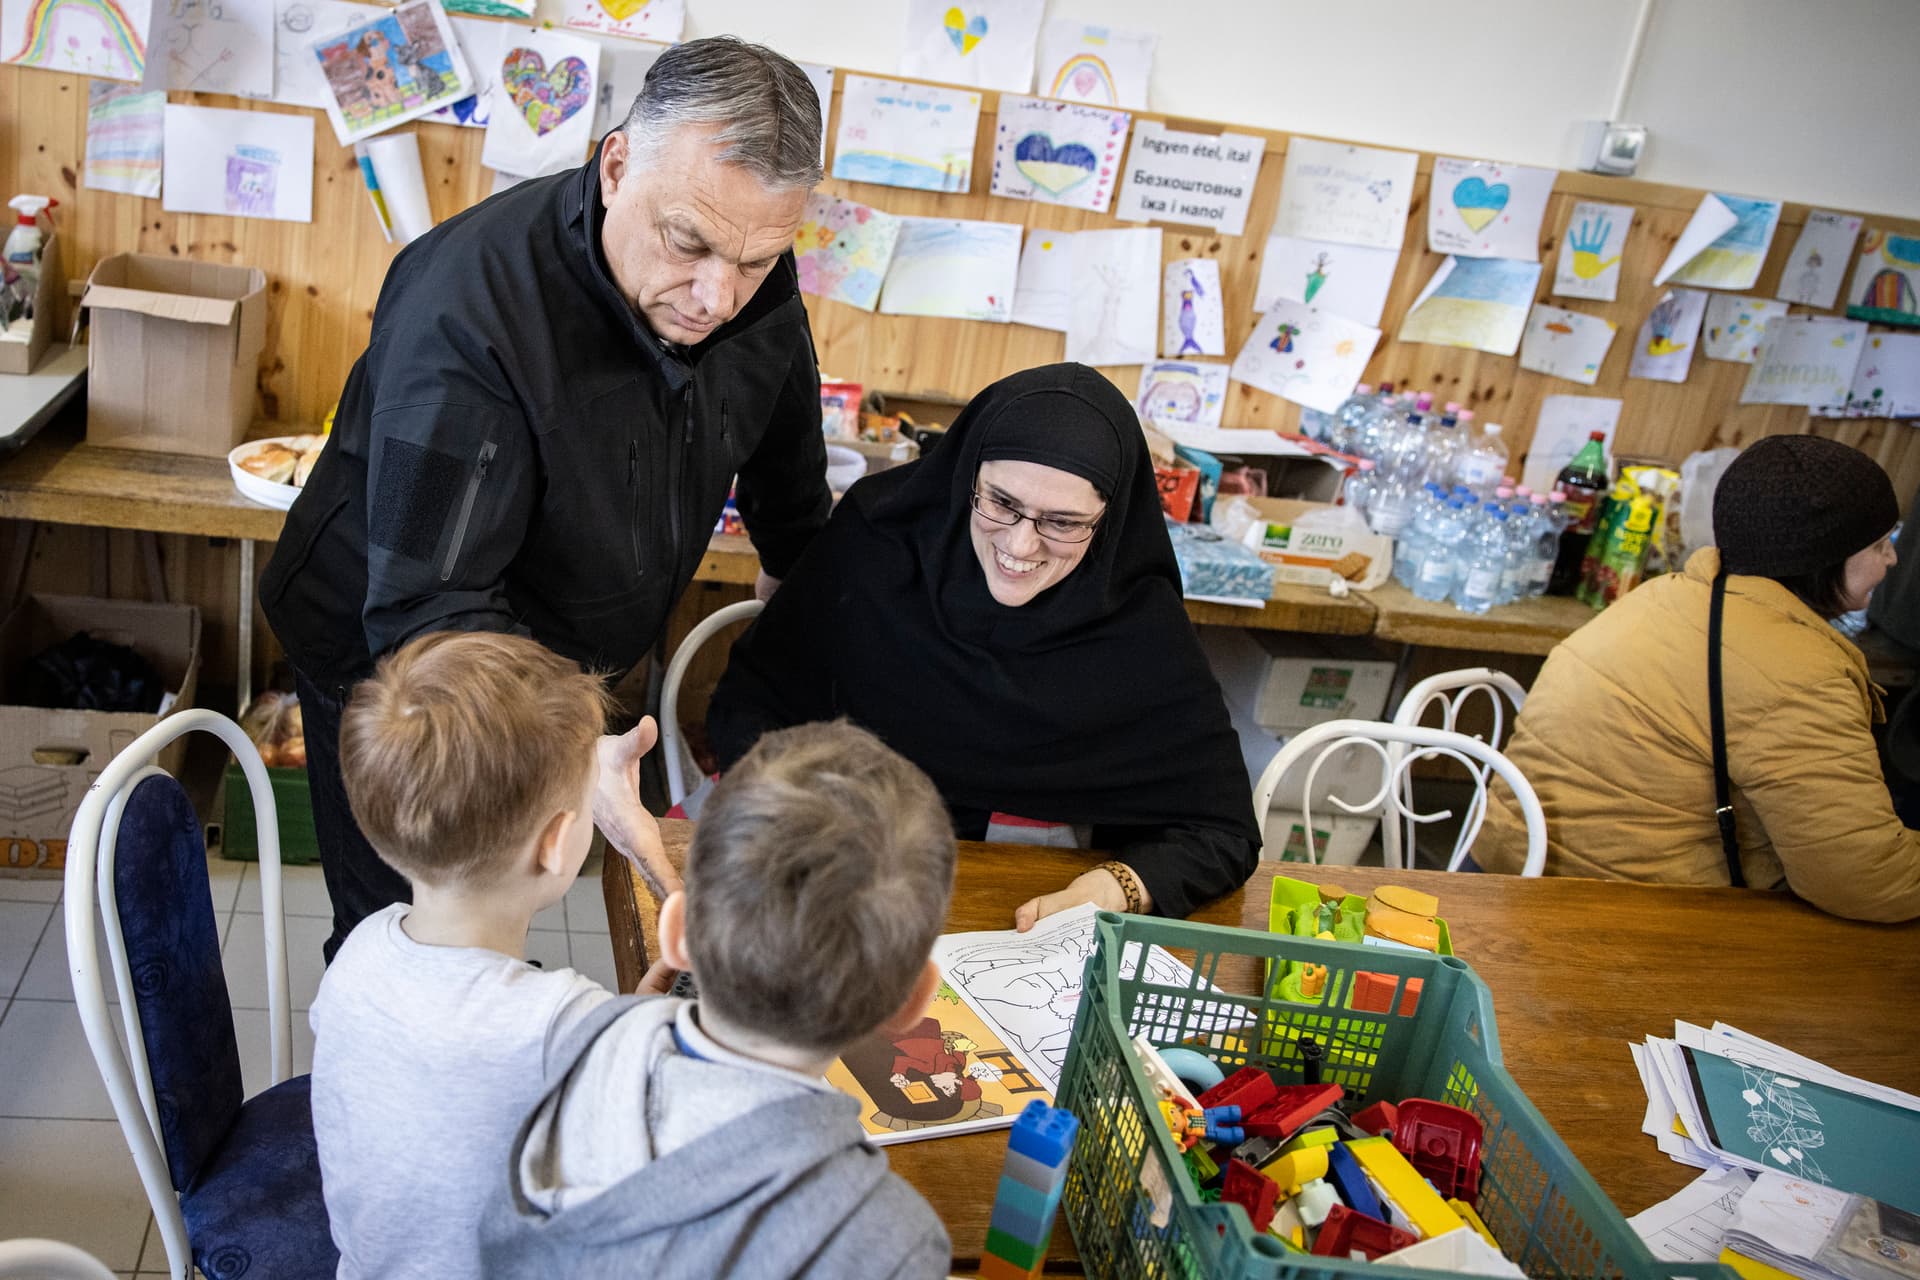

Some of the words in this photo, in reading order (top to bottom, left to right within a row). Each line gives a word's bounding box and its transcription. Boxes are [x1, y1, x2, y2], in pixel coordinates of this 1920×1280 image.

[1142, 136, 1190, 155] Ingyen
[1192, 143, 1223, 161] étel,
[1227, 147, 1251, 162] ital
[1133, 169, 1243, 199] Безкоштовна
[1141, 195, 1166, 212] їжа
[1180, 204, 1226, 220] напої
